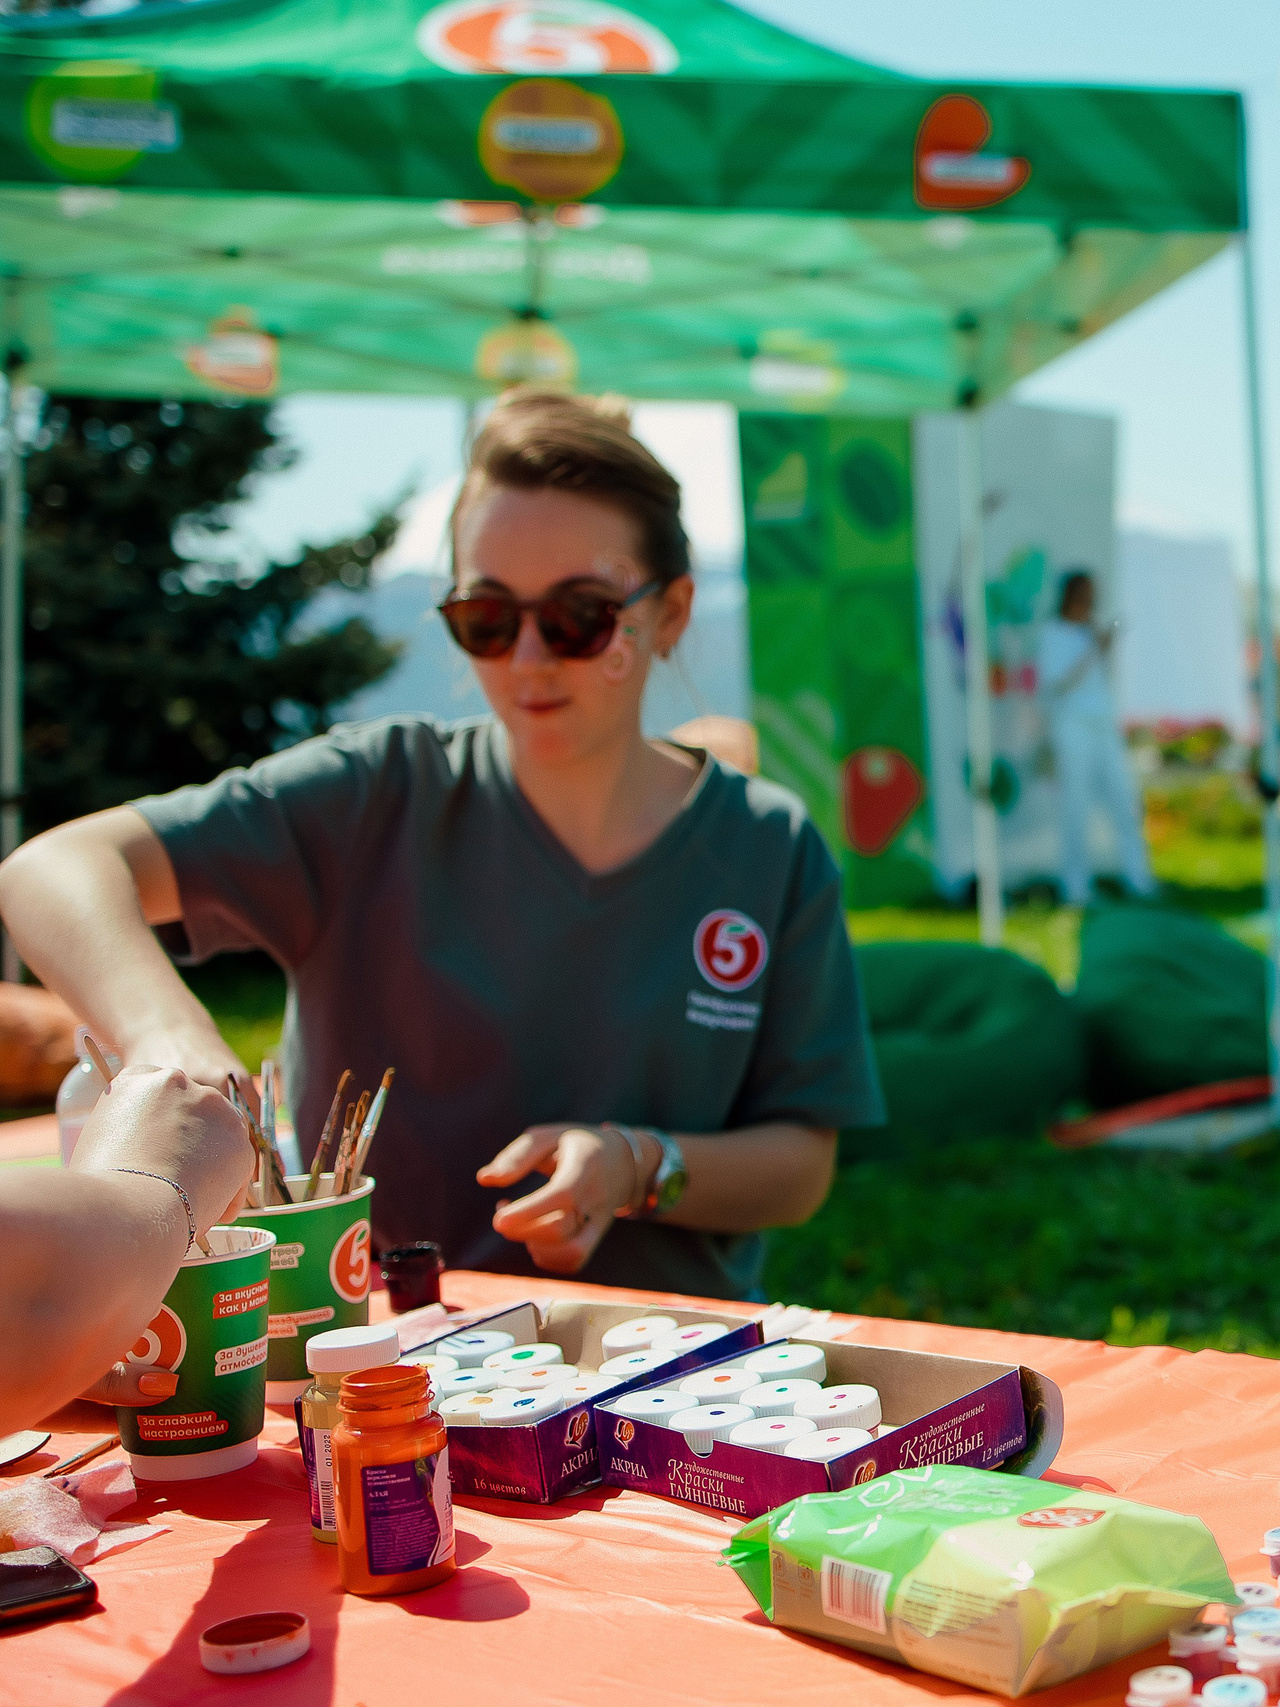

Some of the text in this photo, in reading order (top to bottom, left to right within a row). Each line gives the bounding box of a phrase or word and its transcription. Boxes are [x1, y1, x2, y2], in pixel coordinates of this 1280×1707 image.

[710, 918, 746, 976] 5
[219, 1293, 233, 1304] За
[219, 1303, 239, 1315] как
[241, 1302, 248, 1312] у
[220, 1350, 233, 1361] За
[142, 1414, 213, 1427] За сладким
[144, 1423, 225, 1440] настроением
[918, 1402, 986, 1443] художественные
[323, 1434, 332, 1453] 2022
[899, 1425, 963, 1469] Краски
[981, 1434, 1023, 1463] 12 цветов
[610, 1456, 649, 1479] АКРИЛ
[667, 1458, 724, 1493] Краски
[683, 1461, 745, 1484] художественные
[474, 1477, 527, 1496] 16 цветов
[669, 1482, 747, 1515] ГЛЯНЦЕВЫЕ
